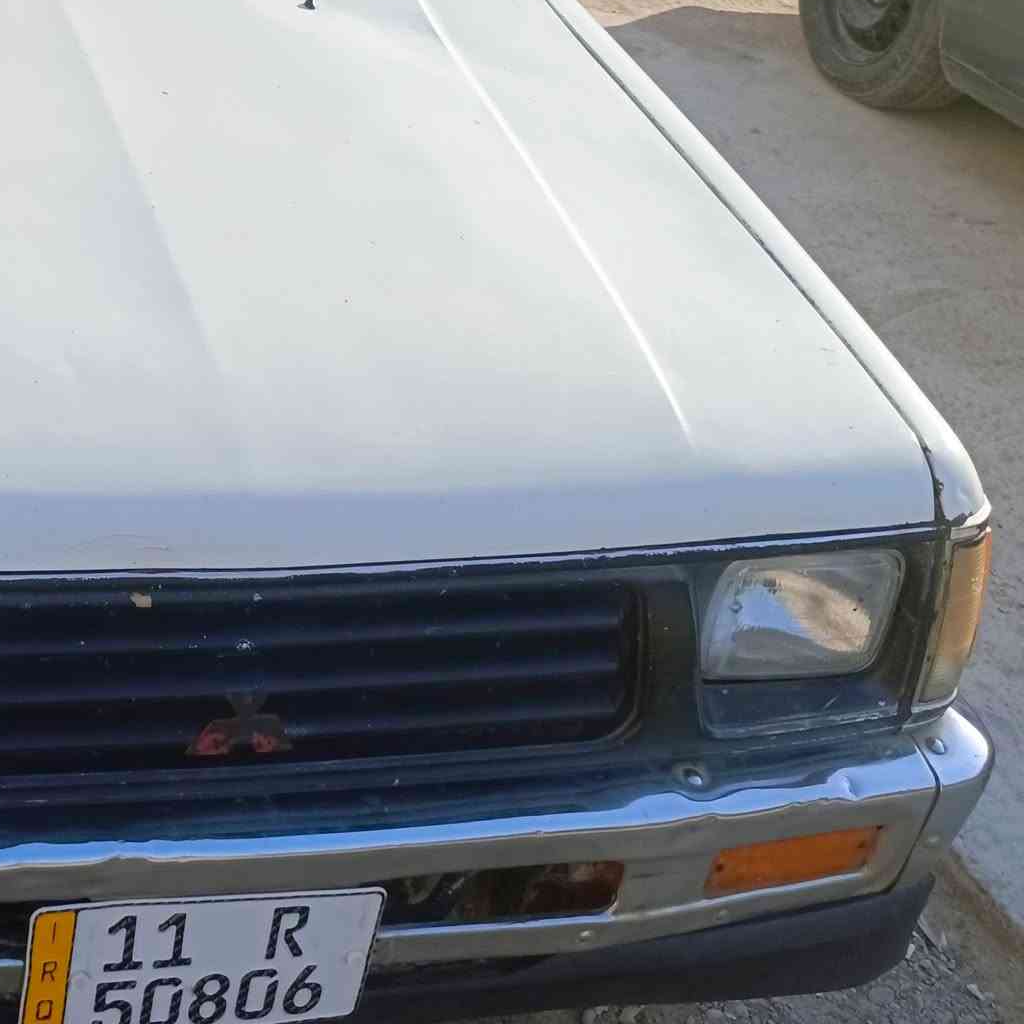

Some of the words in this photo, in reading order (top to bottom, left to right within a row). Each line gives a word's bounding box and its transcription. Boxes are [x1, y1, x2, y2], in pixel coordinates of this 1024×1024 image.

[103, 913, 192, 972] 11
[264, 905, 310, 959] R
[91, 964, 323, 1024] 50806
